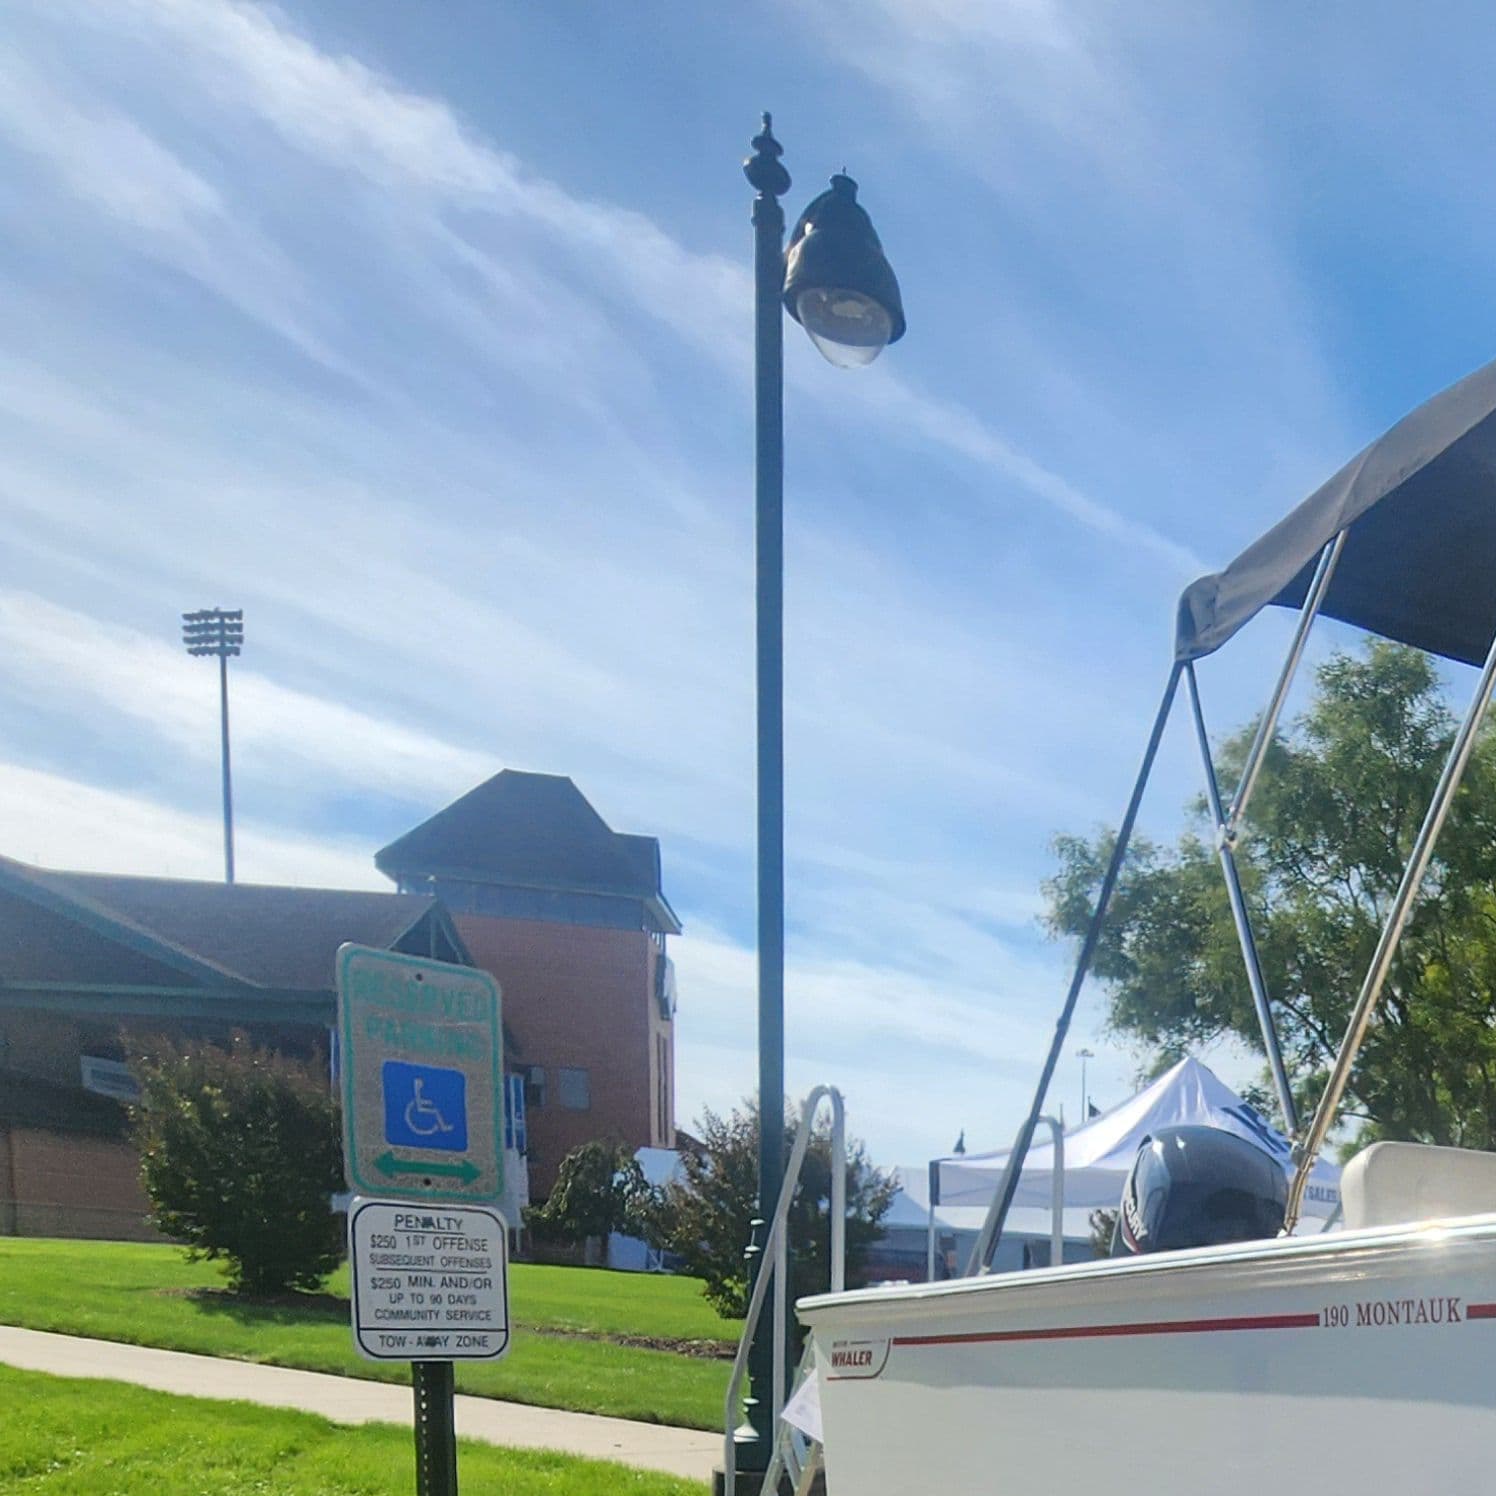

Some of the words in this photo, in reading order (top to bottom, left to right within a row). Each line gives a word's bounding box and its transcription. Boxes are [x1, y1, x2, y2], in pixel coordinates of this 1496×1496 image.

[395, 1214, 463, 1231] PENALTY
[370, 1234, 397, 1249] $250
[406, 1236, 426, 1248] 1ST
[433, 1237, 489, 1252] OFFENSE
[369, 1253, 435, 1267] SUBSEQUENT
[440, 1256, 492, 1269] OFFENSES
[370, 1277, 401, 1290] $250
[440, 1278, 493, 1289] AND/OR
[389, 1293, 405, 1304] UP
[410, 1293, 425, 1304] TO
[430, 1294, 443, 1305] 90
[448, 1294, 478, 1305] DAYS
[374, 1308, 440, 1321] COMMUNITY
[446, 1310, 492, 1321] SERVICE
[1323, 1305, 1349, 1327] 190
[1356, 1297, 1462, 1327] MONTAUK
[456, 1335, 489, 1348] ZONE
[831, 1350, 873, 1367] WHALER
